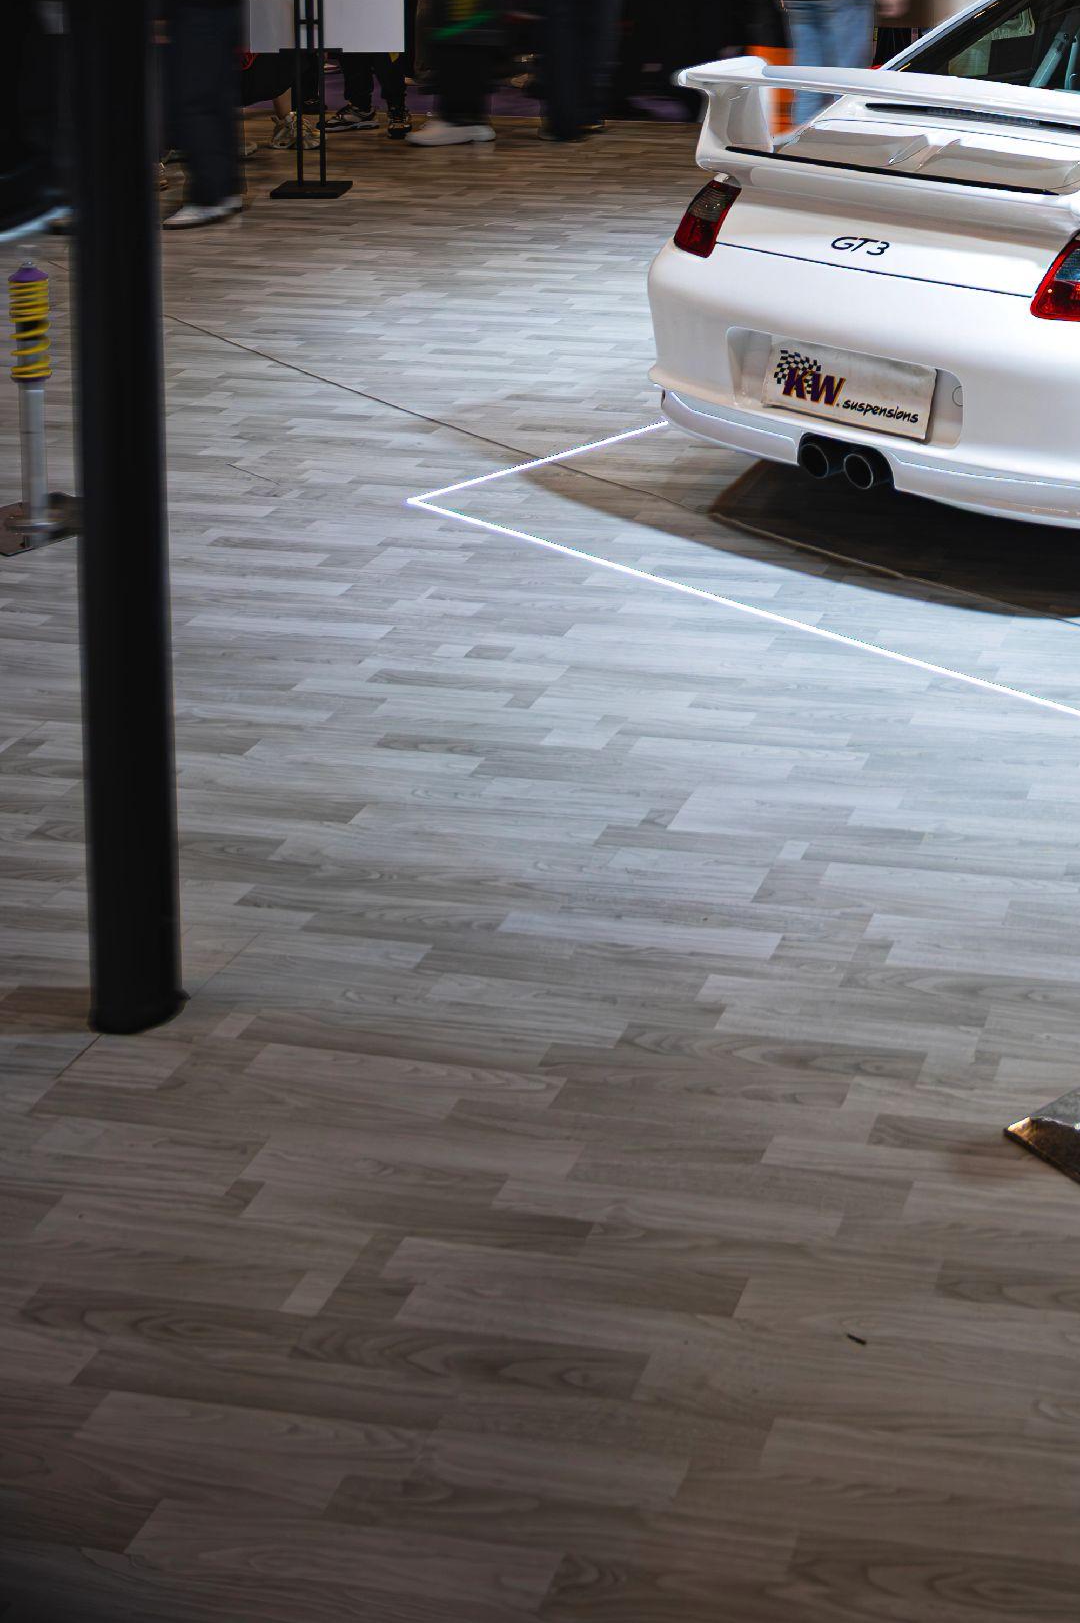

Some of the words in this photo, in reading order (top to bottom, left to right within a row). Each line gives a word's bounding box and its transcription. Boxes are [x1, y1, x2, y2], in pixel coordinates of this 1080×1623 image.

[831, 236, 890, 256] GT3
[782, 365, 846, 407] KW
[842, 398, 919, 424] suspensions
